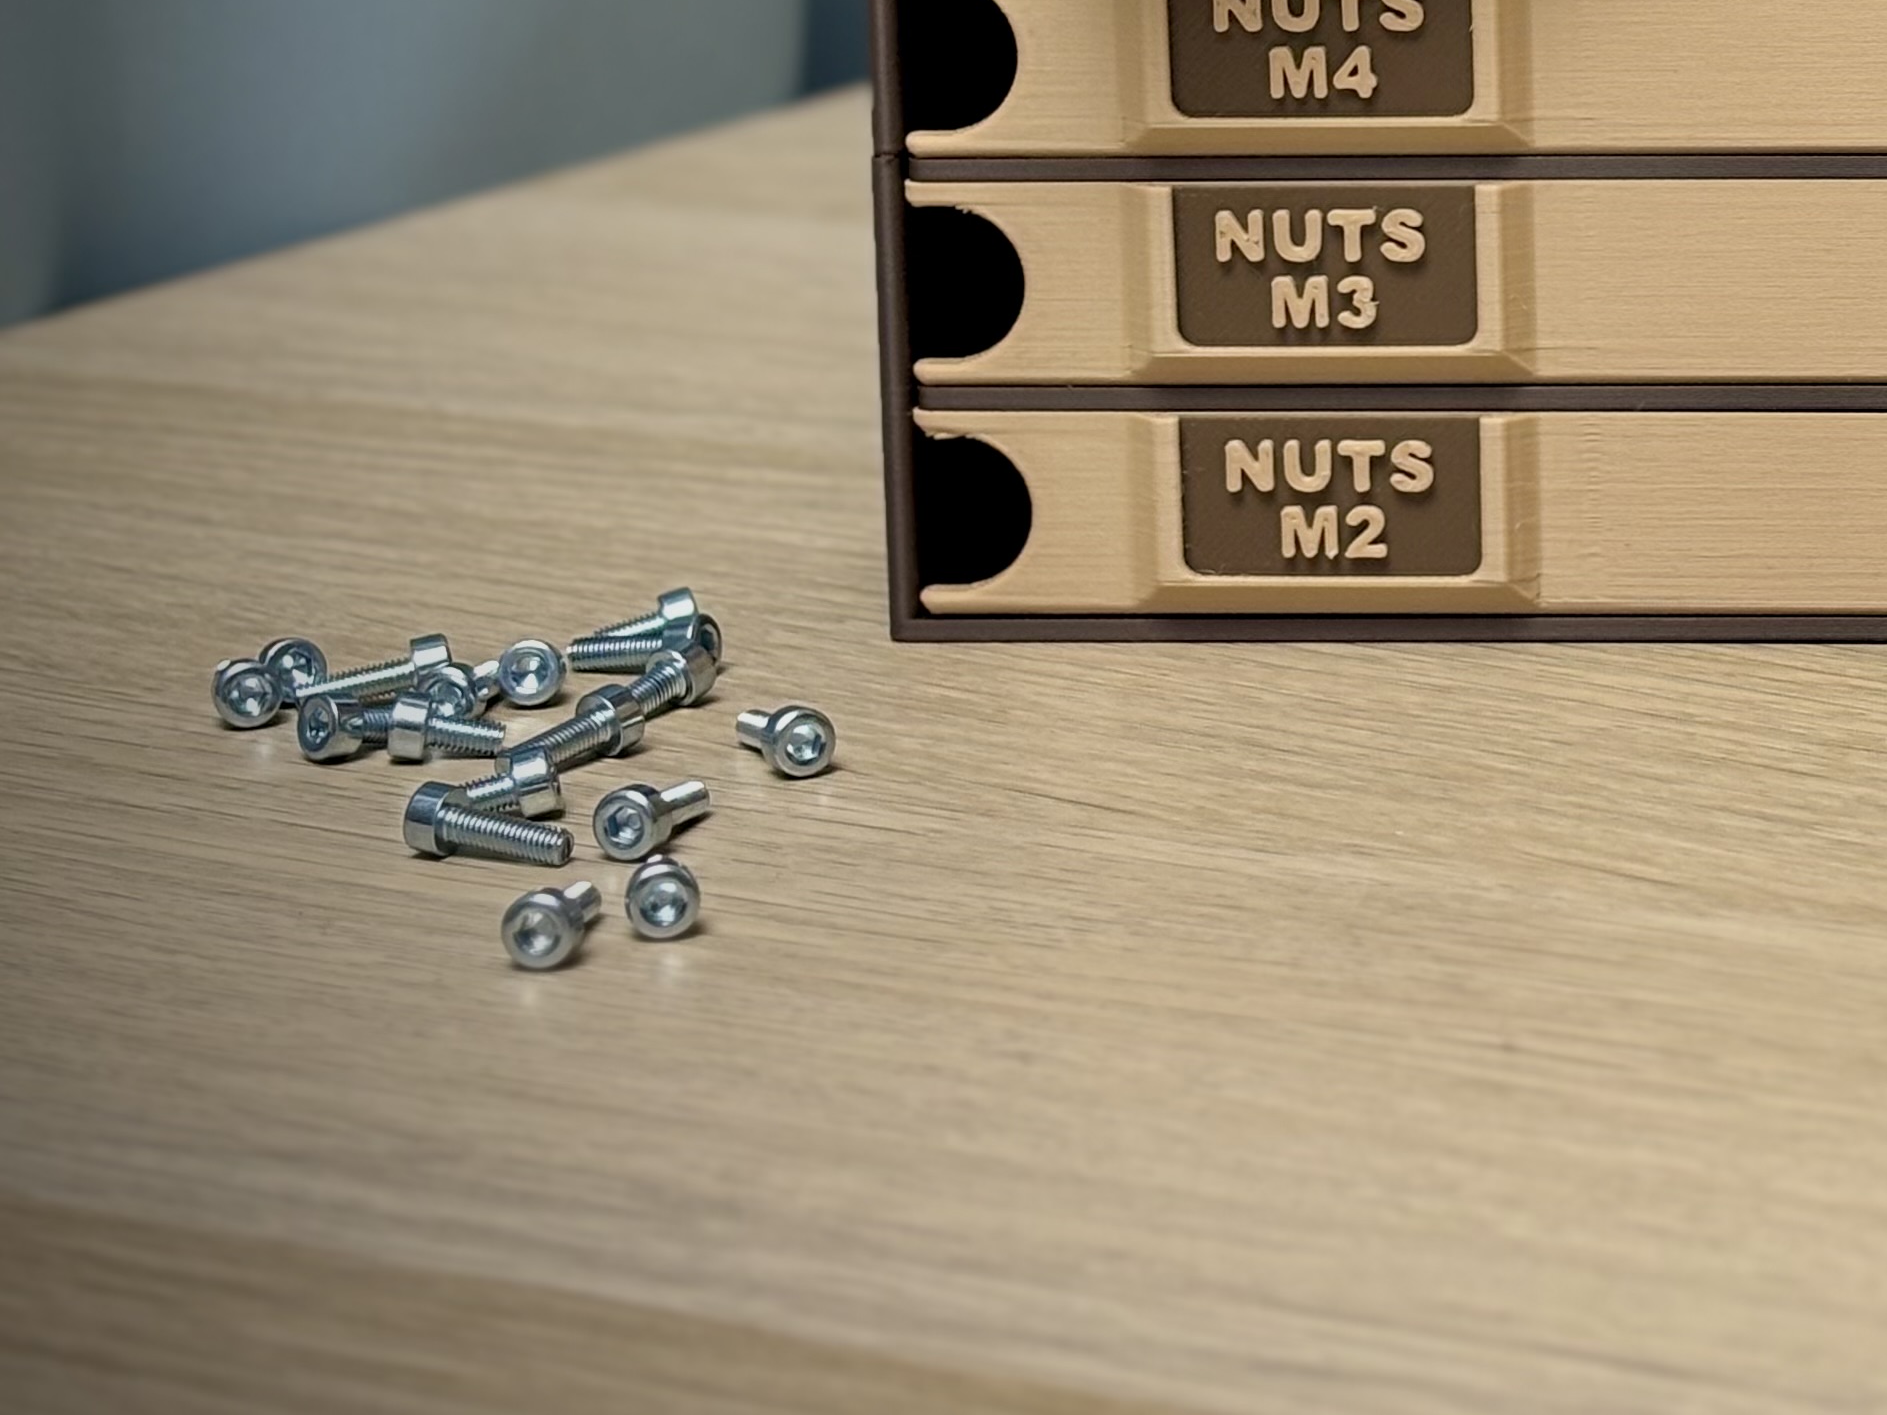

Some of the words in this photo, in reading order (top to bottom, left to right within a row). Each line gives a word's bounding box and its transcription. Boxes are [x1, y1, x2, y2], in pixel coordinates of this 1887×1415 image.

[1268, 44, 1379, 100] M4
[1214, 208, 1426, 264] NUTS
[1270, 275, 1380, 330] M3
[1224, 438, 1435, 494] NUTS
[1280, 505, 1389, 559] M2
